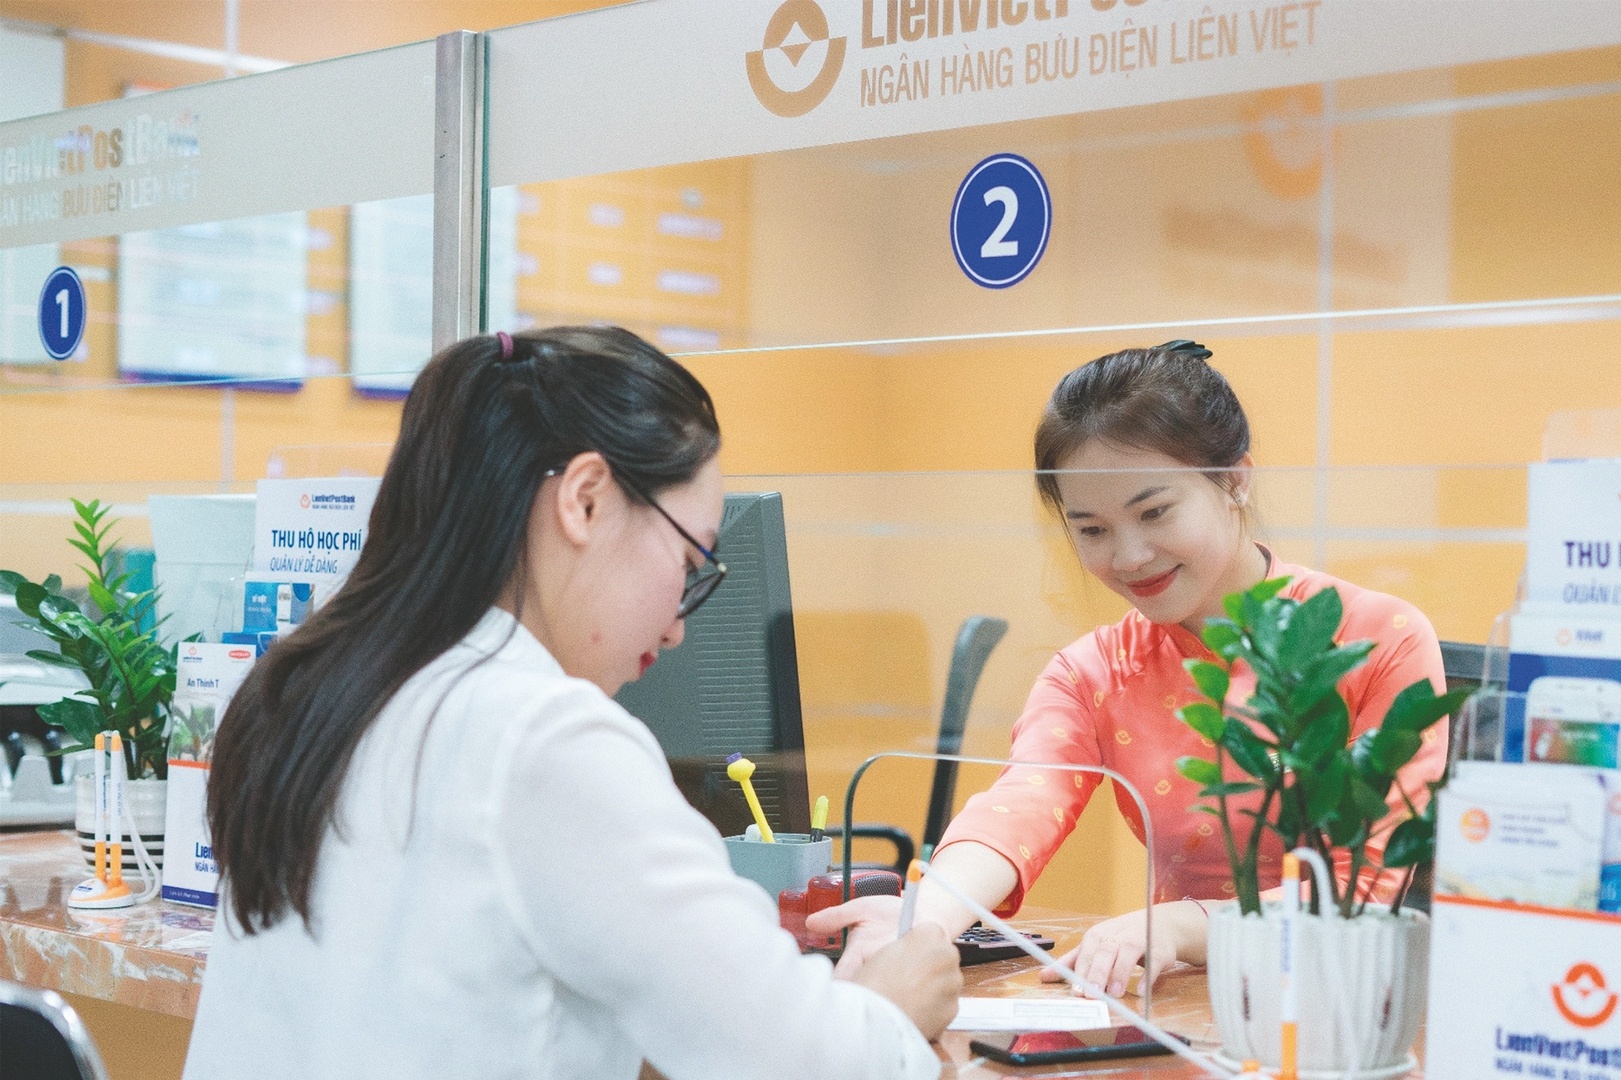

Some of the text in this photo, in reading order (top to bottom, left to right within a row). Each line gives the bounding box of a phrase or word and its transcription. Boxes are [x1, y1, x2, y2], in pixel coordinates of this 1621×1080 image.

[861, 0, 1153, 49] LienVie
[860, 52, 930, 108] NGÂN
[940, 43, 1014, 96] HÀNG
[1024, 32, 1080, 85] BƯU
[1088, 18, 1159, 79] ĐIỆN
[1169, 5, 1239, 65] LIÊN
[980, 185, 1019, 258] 2
[55, 288, 70, 338] 1
[271, 527, 362, 555] THU HỘ HỌC PHÍ
[1563, 541, 1610, 569] THU
